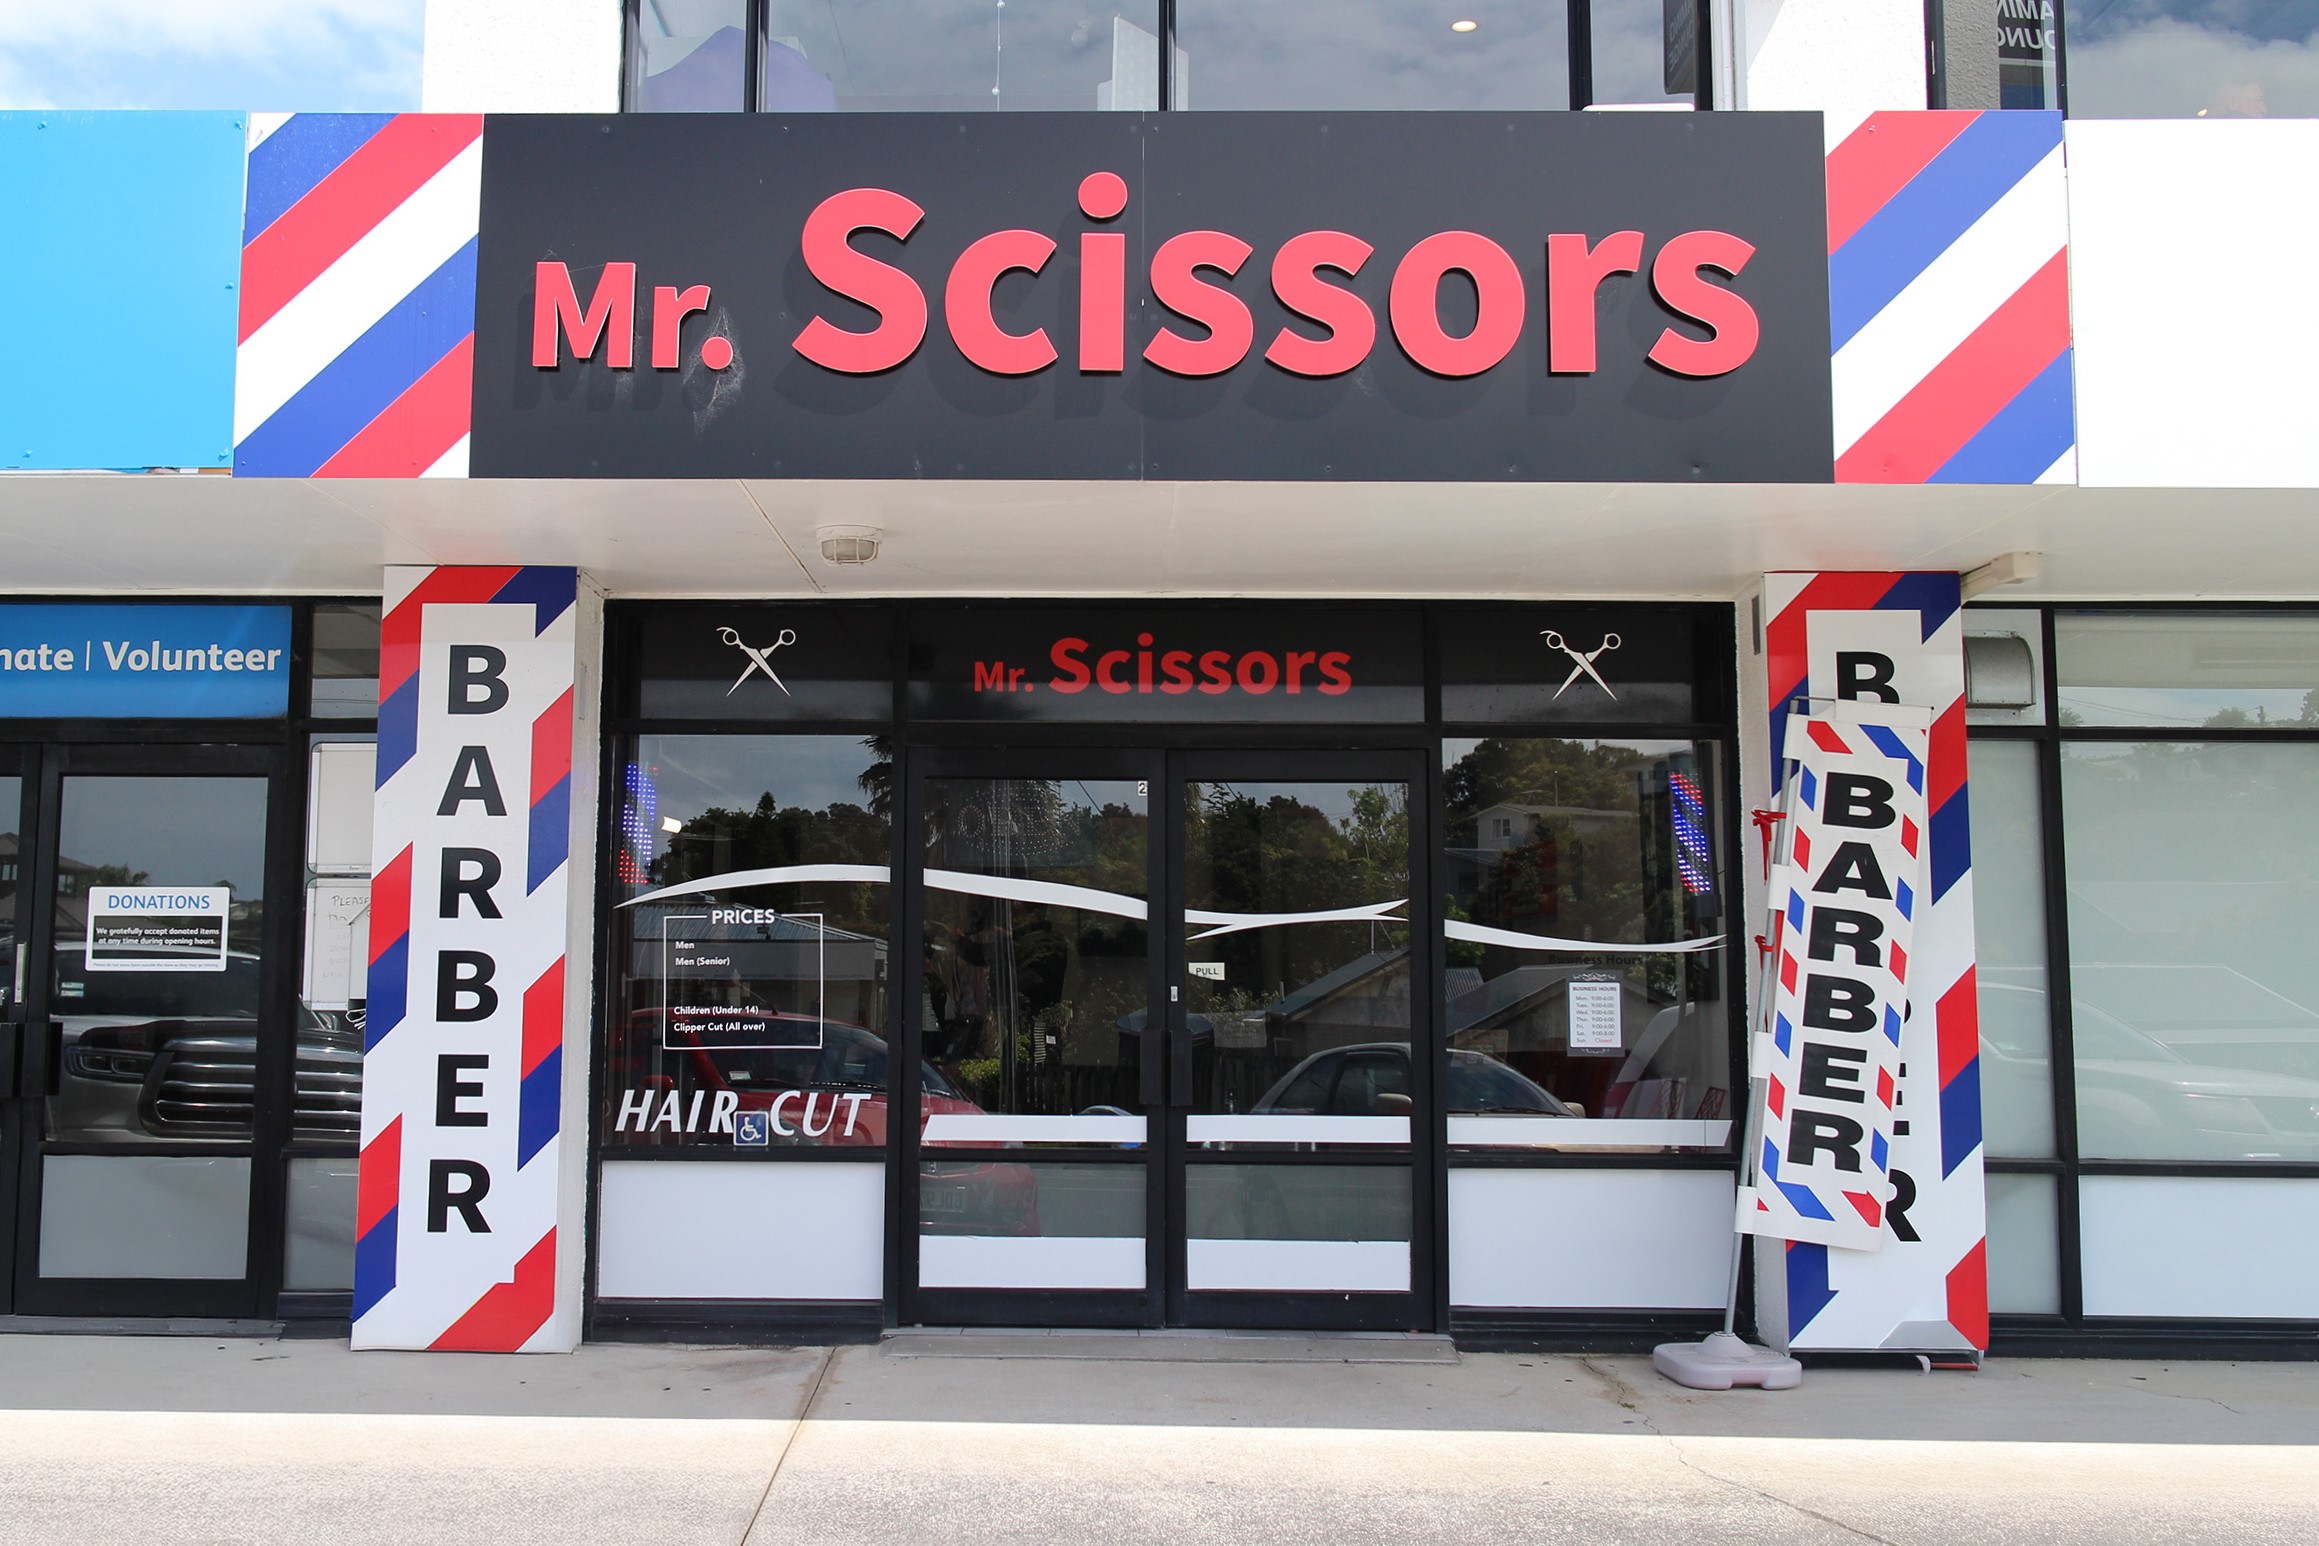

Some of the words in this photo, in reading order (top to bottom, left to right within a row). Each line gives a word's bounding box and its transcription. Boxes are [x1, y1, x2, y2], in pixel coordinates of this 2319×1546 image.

[532, 261, 734, 370] Mr.
[792, 171, 1759, 376] Scissors
[103, 640, 282, 672] Volunteer
[973, 661, 1034, 693] Mr.
[1048, 632, 1352, 696] Scissors
[1138, 781, 1147, 795] 2
[108, 895, 210, 909] DONATIONS
[711, 909, 775, 925] PRICES
[96, 927, 108, 935] We
[109, 927, 143, 936] gratefully
[144, 928, 168, 936] accept
[169, 927, 199, 935] donated
[200, 927, 220, 935] items
[426, 643, 509, 1234] BARBER
[122, 937, 139, 945] time
[140, 937, 163, 946] during
[164, 938, 193, 946] opening
[194, 937, 216, 945] hours.
[675, 958, 695, 966] Men
[696, 957, 730, 967] (Senior)
[1548, 954, 1602, 965] Business
[1606, 954, 1643, 965] Hours
[1195, 967, 1219, 976] PULL
[1787, 771, 1896, 1174] BARBER
[673, 1006, 711, 1015] Children
[712, 1005, 742, 1015] (Under
[745, 1005, 759, 1015] 14)
[673, 1022, 706, 1034] Clipper
[707, 1022, 724, 1031] Cut
[725, 1022, 741, 1031] (All
[742, 1022, 766, 1031] over)
[614, 1089, 739, 1134] HAIR
[769, 1090, 872, 1137] CUT
